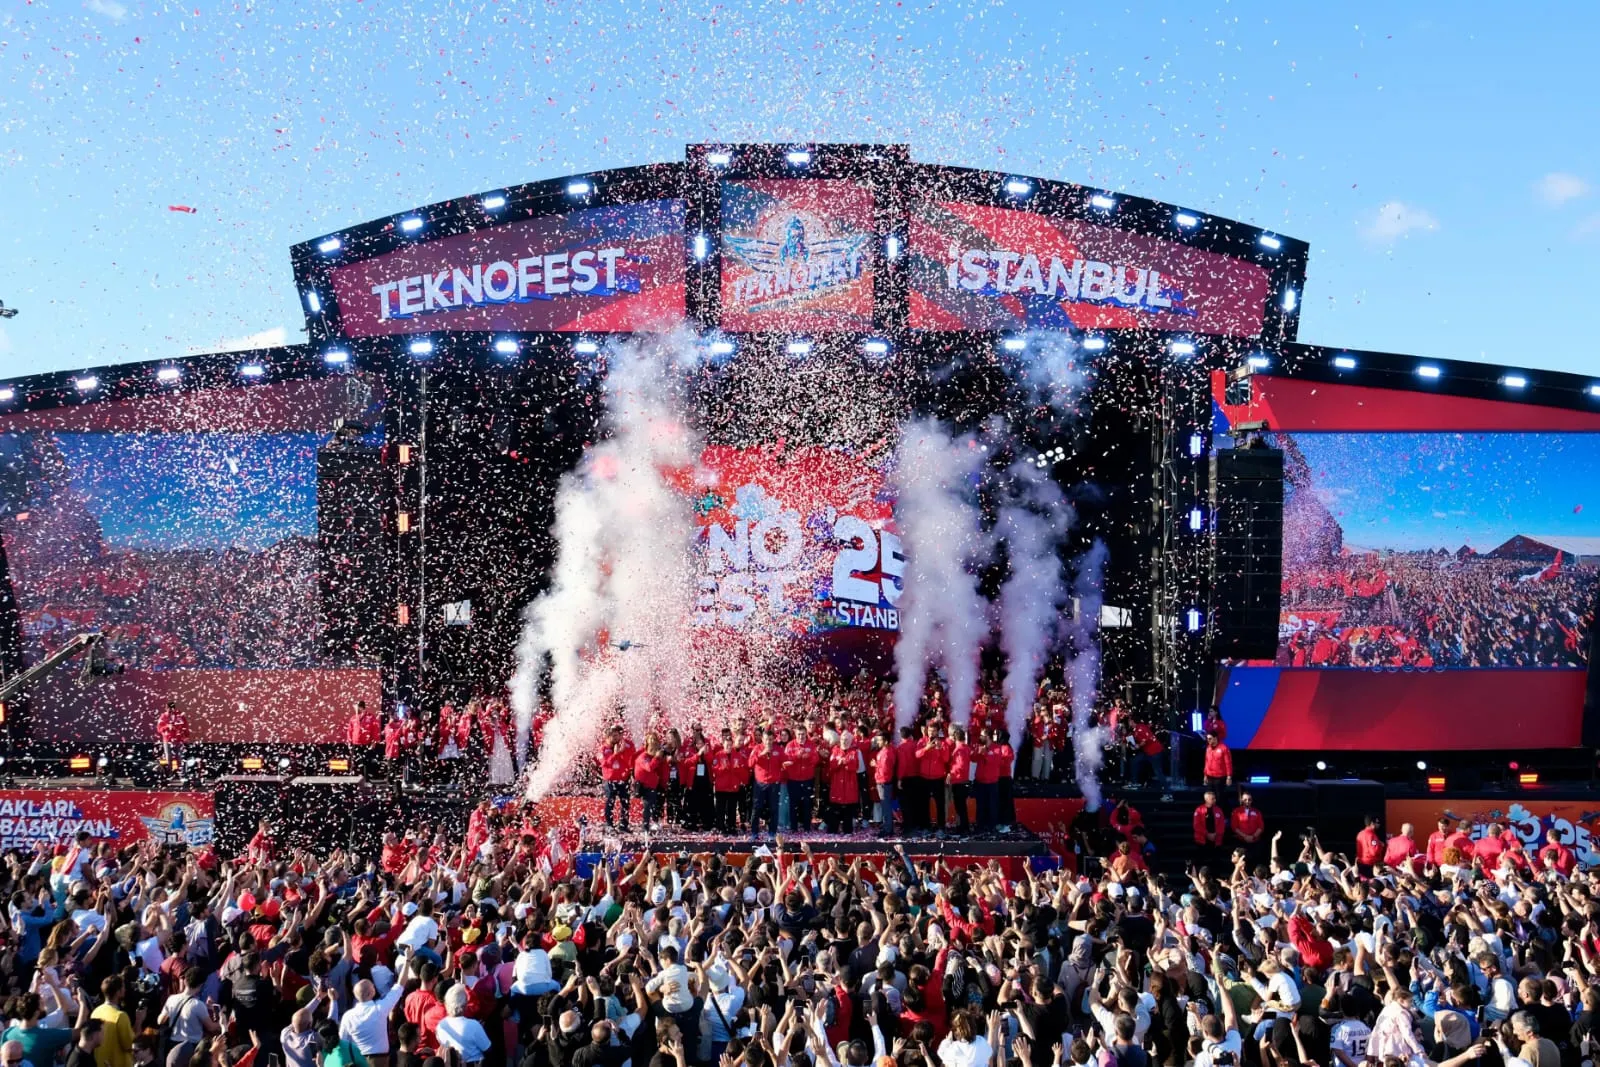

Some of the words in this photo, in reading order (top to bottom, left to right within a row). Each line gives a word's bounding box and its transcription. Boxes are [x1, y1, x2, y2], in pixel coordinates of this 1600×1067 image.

[372, 247, 625, 319] TEKNOFEST
[948, 249, 1172, 308] İSTANBUL
[832, 602, 900, 630] İSTANB
[0, 799, 74, 817] AKLARI
[0, 818, 111, 837] BASMAYAN
[1351, 1039, 1367, 1057] 15
